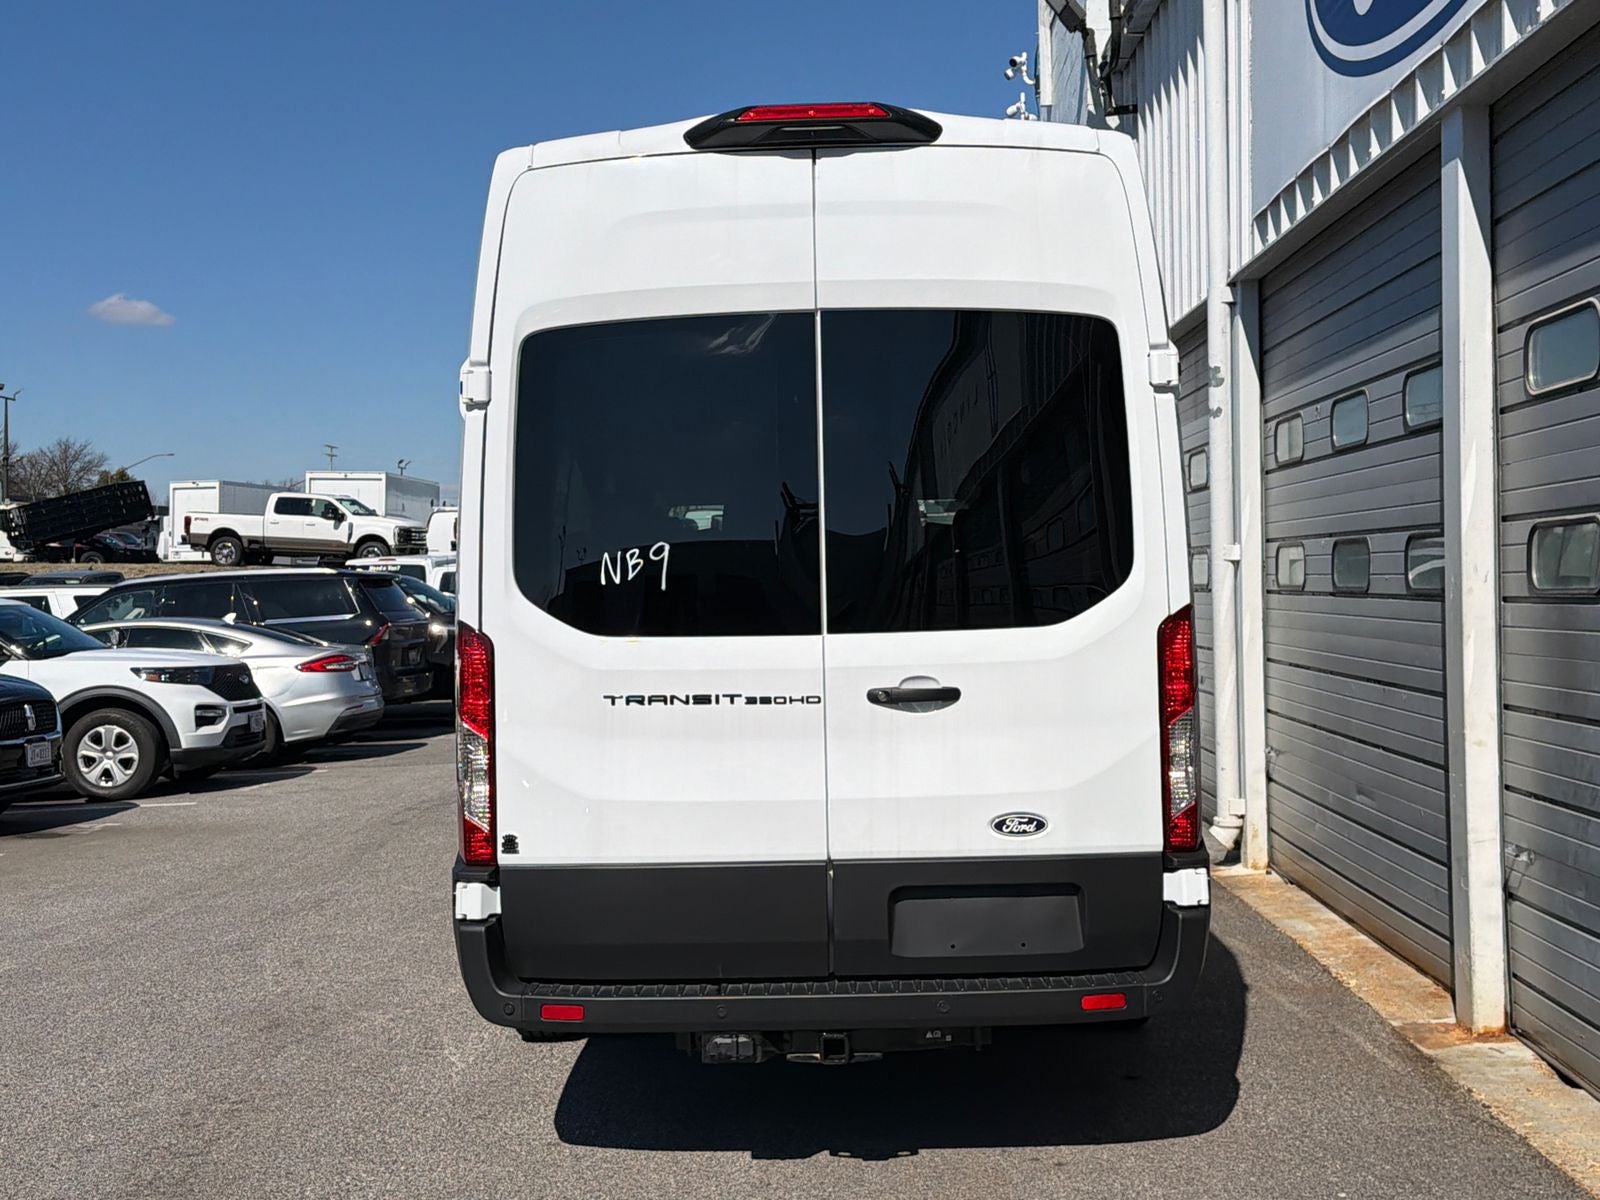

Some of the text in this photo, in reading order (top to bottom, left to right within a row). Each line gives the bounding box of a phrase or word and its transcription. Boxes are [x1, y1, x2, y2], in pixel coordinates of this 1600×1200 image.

[600, 541, 671, 592] NB9
[603, 694, 742, 706] TRANSIT
[1002, 818, 1038, 832] Ford
